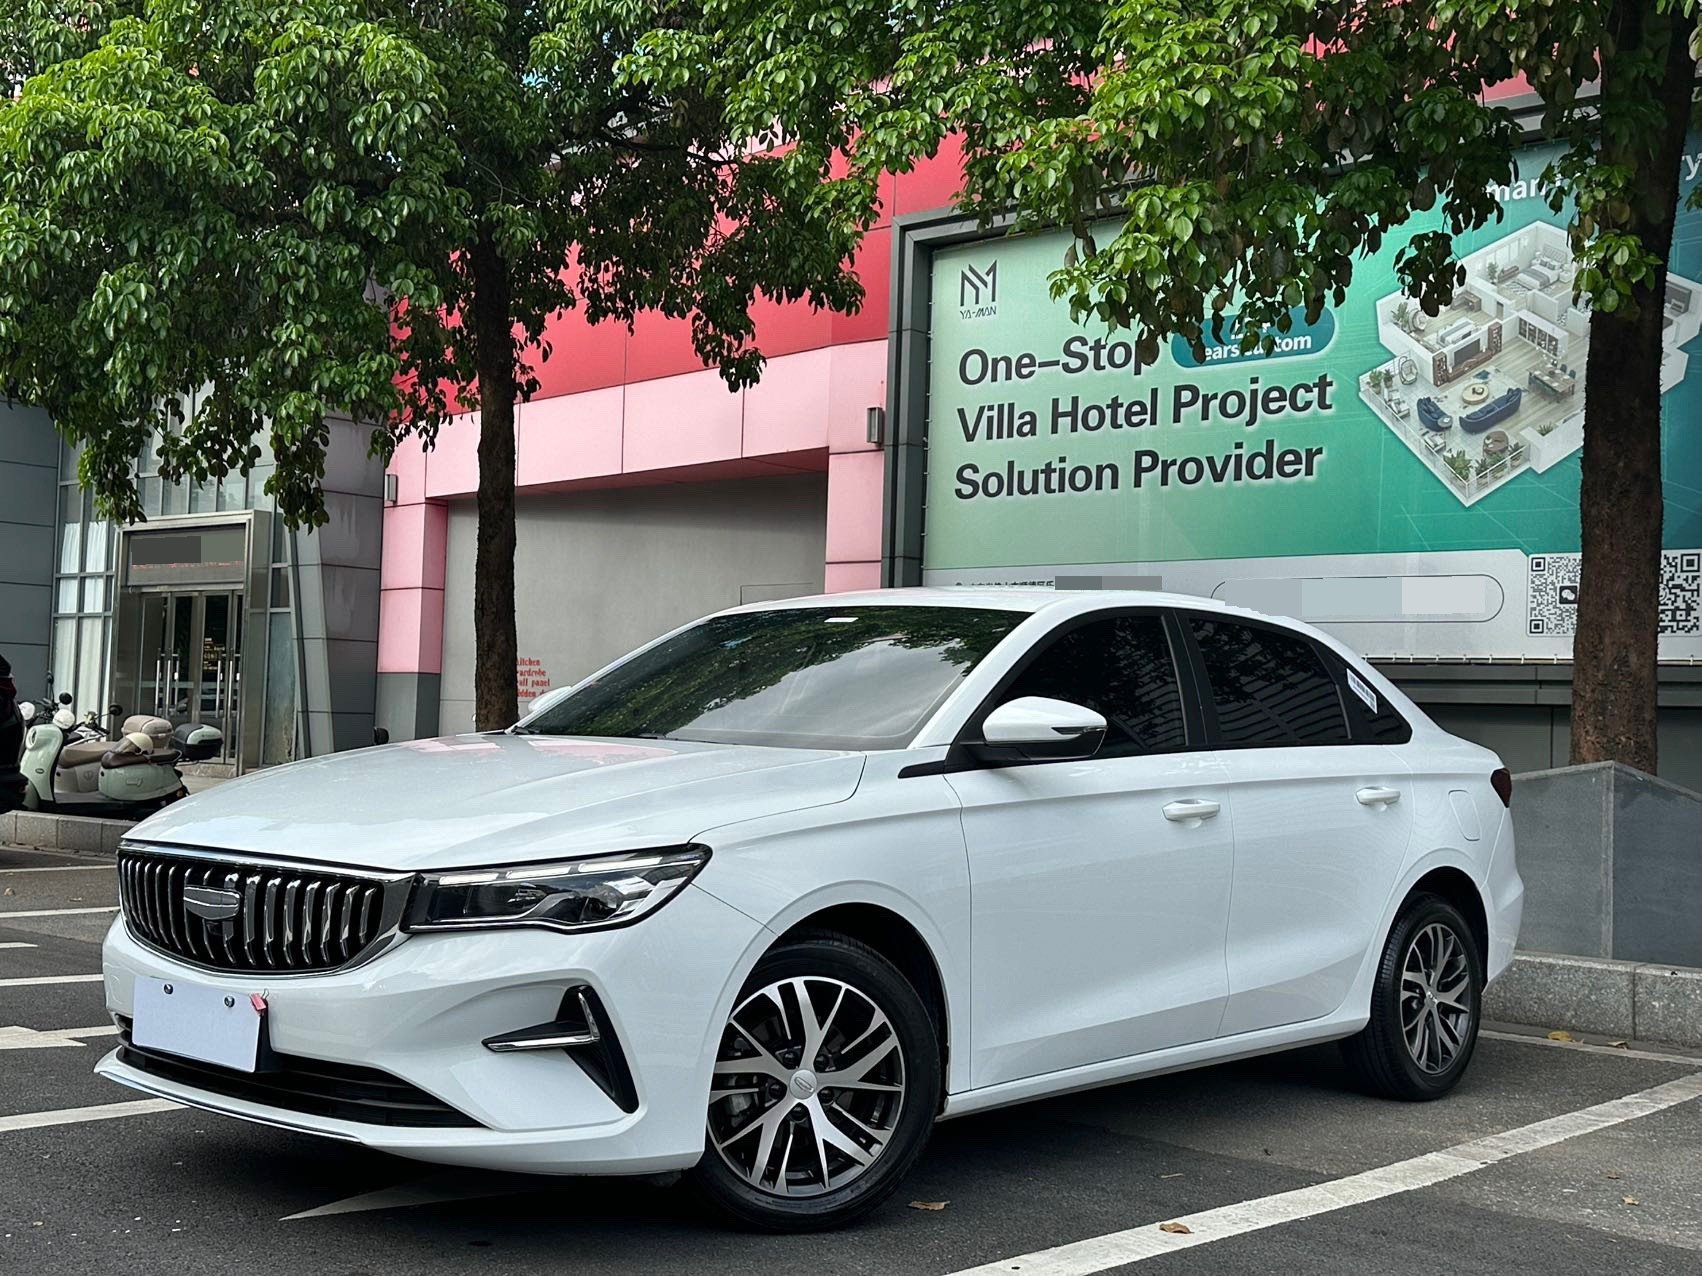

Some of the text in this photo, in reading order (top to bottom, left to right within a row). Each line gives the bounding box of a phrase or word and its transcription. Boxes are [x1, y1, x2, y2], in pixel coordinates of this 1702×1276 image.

[960, 305, 997, 320] YA-MAN
[1205, 344, 1240, 361] ears
[957, 373, 1334, 442] Villa Hotel Project
[954, 439, 1324, 500] Solution Provider
[517, 657, 541, 666] itchen
[517, 668, 546, 677] ardrobe
[531, 678, 550, 688] panel
